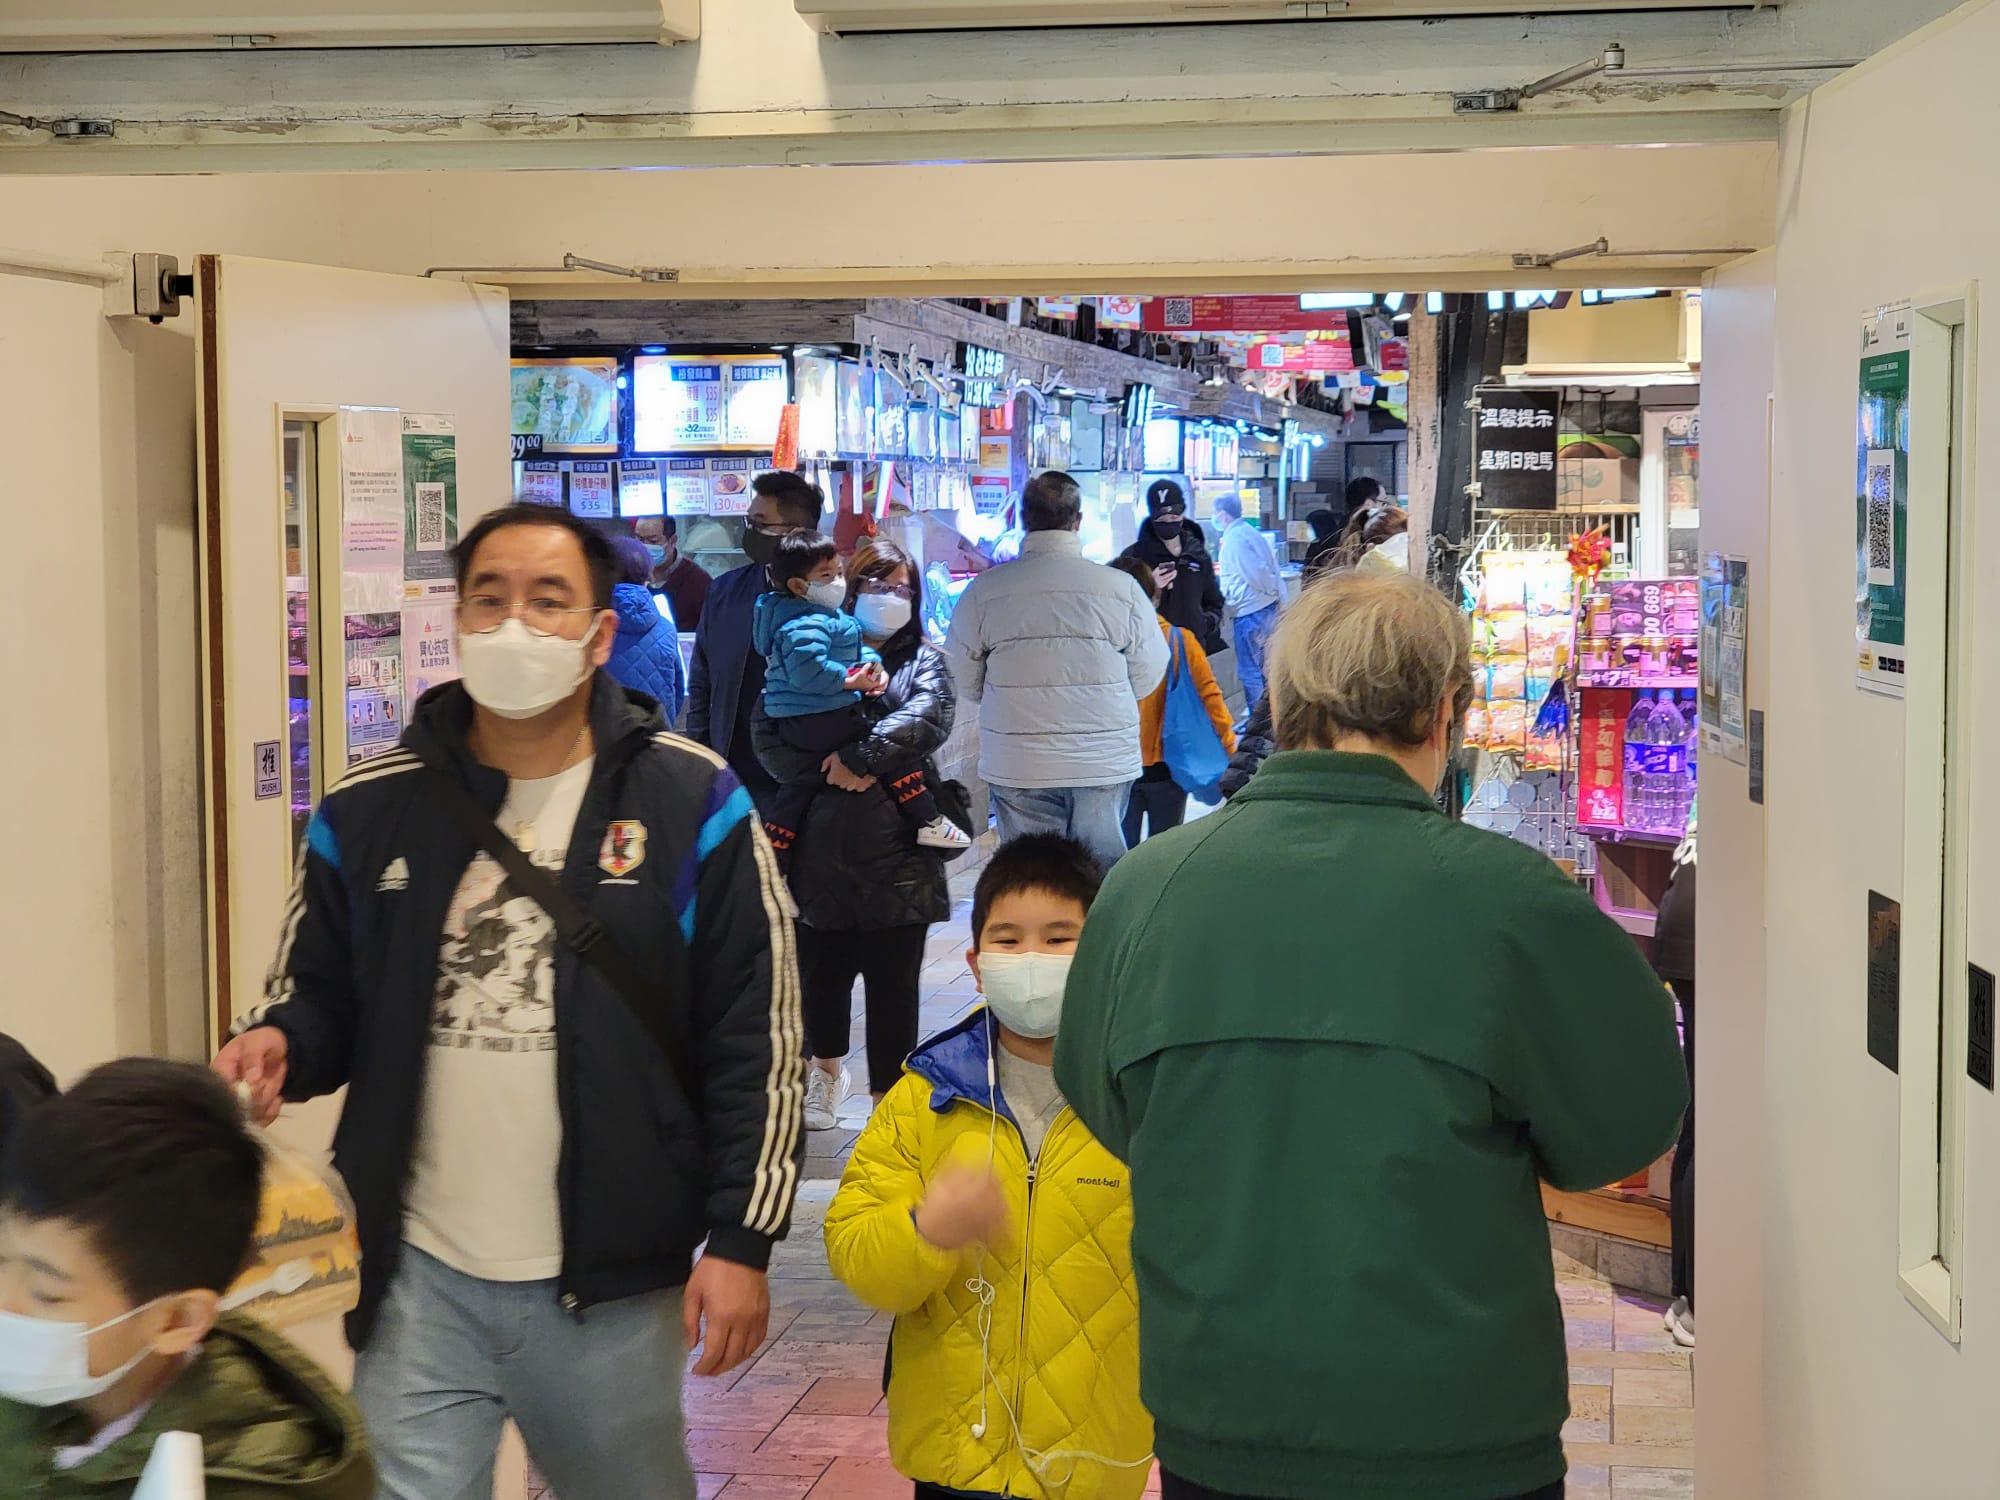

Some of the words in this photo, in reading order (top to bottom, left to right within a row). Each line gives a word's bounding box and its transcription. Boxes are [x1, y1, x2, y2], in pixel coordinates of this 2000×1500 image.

[1479, 449, 1554, 471] 星期日跑馬
[580, 501, 601, 510] $35
[262, 748, 275, 777] 推
[261, 783, 277, 793] PUSH
